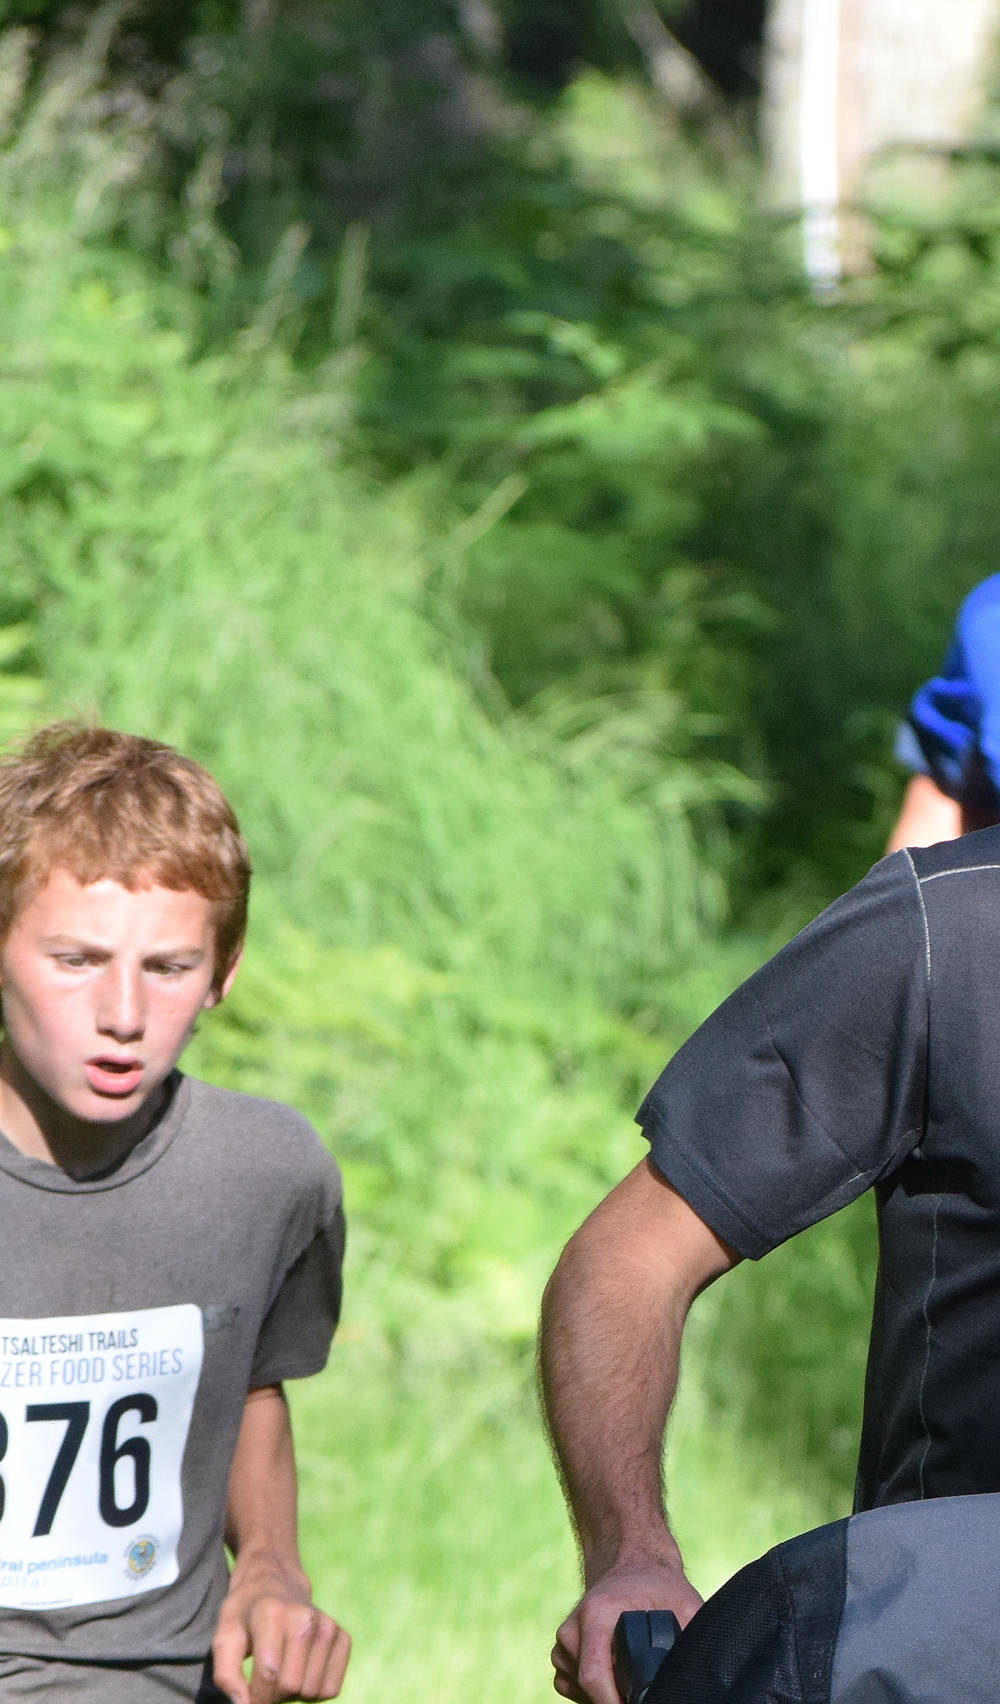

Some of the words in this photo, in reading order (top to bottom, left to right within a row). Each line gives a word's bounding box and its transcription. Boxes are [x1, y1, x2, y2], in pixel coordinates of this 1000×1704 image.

[1, 1333, 83, 1356] TSALTESHI
[88, 1328, 139, 1350] TRAILS
[50, 1356, 105, 1385] FOOD
[112, 1348, 183, 1381] SERIES
[0, 1392, 158, 1538] 76
[26, 1551, 109, 1574] peninsula
